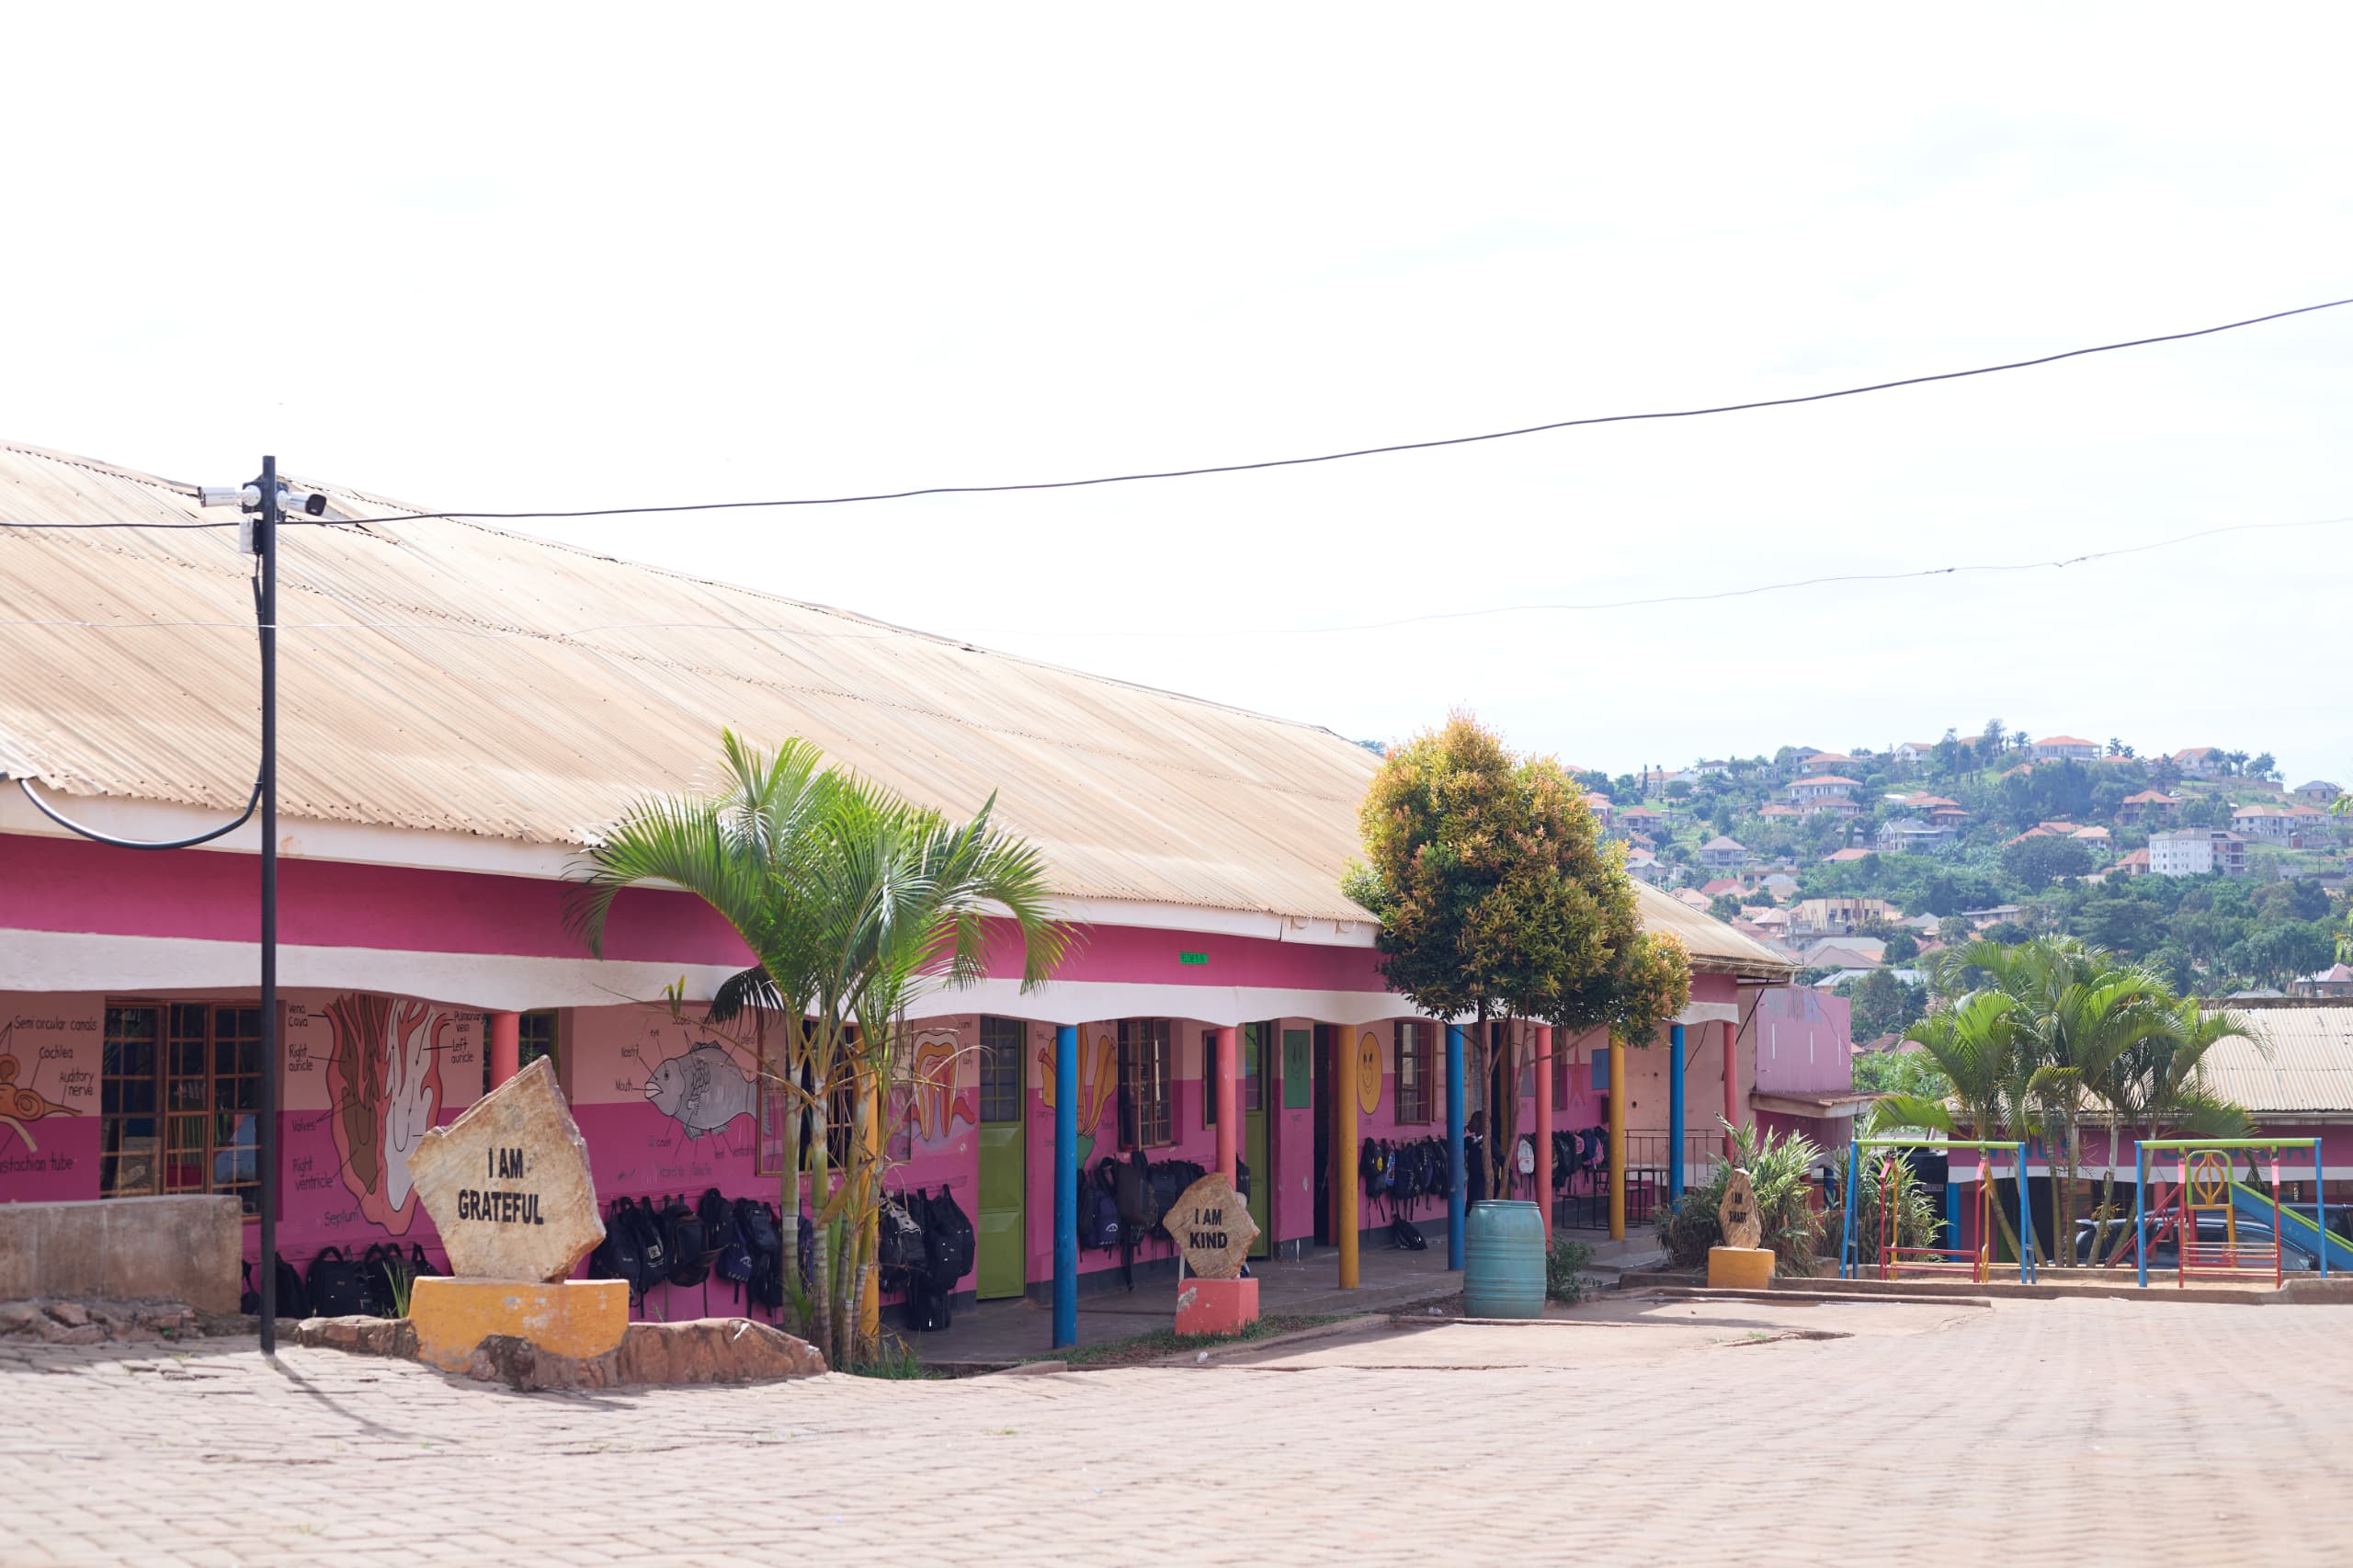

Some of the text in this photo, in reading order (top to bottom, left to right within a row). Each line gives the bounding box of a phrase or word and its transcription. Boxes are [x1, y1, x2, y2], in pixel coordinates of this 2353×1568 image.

[39, 1044, 74, 1059] Cochlea
[68, 1086, 94, 1096] nerve
[488, 1148, 523, 1179] I AM
[458, 1189, 544, 1225] GRATEFUL
[1194, 1208, 1222, 1226] I AM
[1189, 1232, 1228, 1249] KIND
